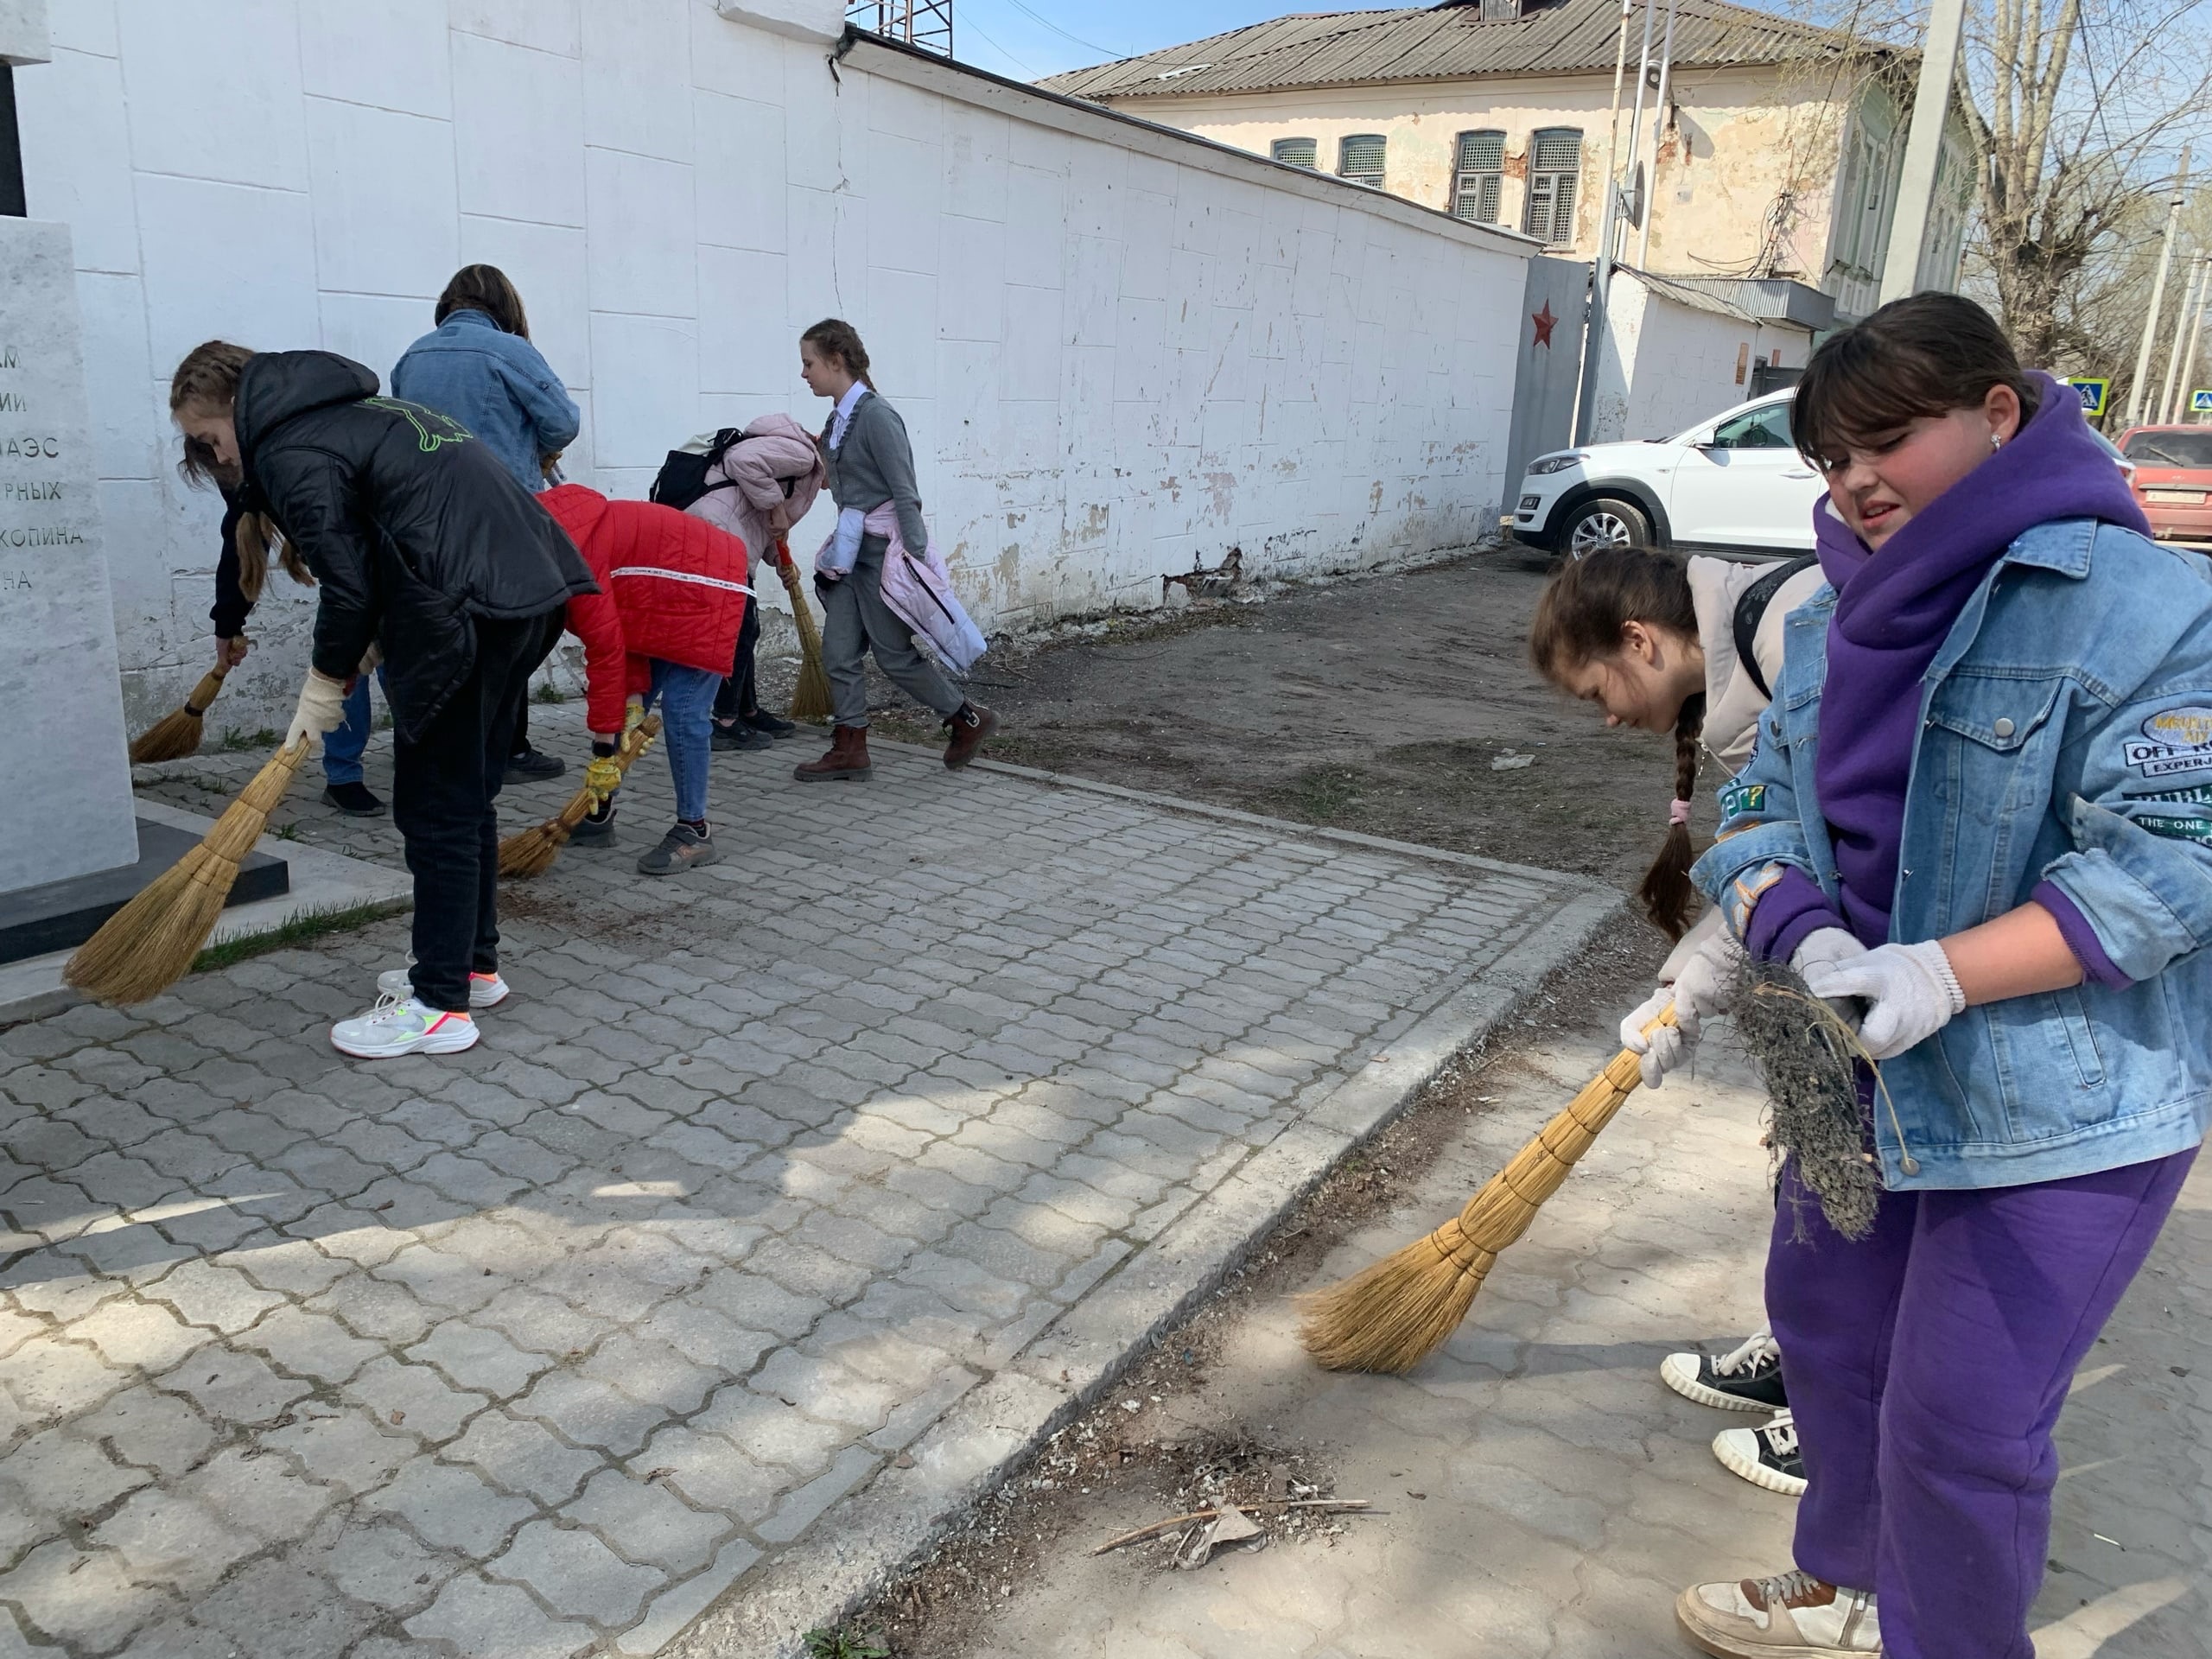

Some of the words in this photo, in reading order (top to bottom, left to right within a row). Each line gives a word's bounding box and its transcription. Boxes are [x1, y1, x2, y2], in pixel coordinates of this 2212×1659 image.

[0, 345, 21, 369] М
[0, 437, 59, 458] АЭС
[5, 481, 61, 500] РНЫХ
[2139, 817, 2164, 828] THE
[2173, 820, 2207, 830] ONE
